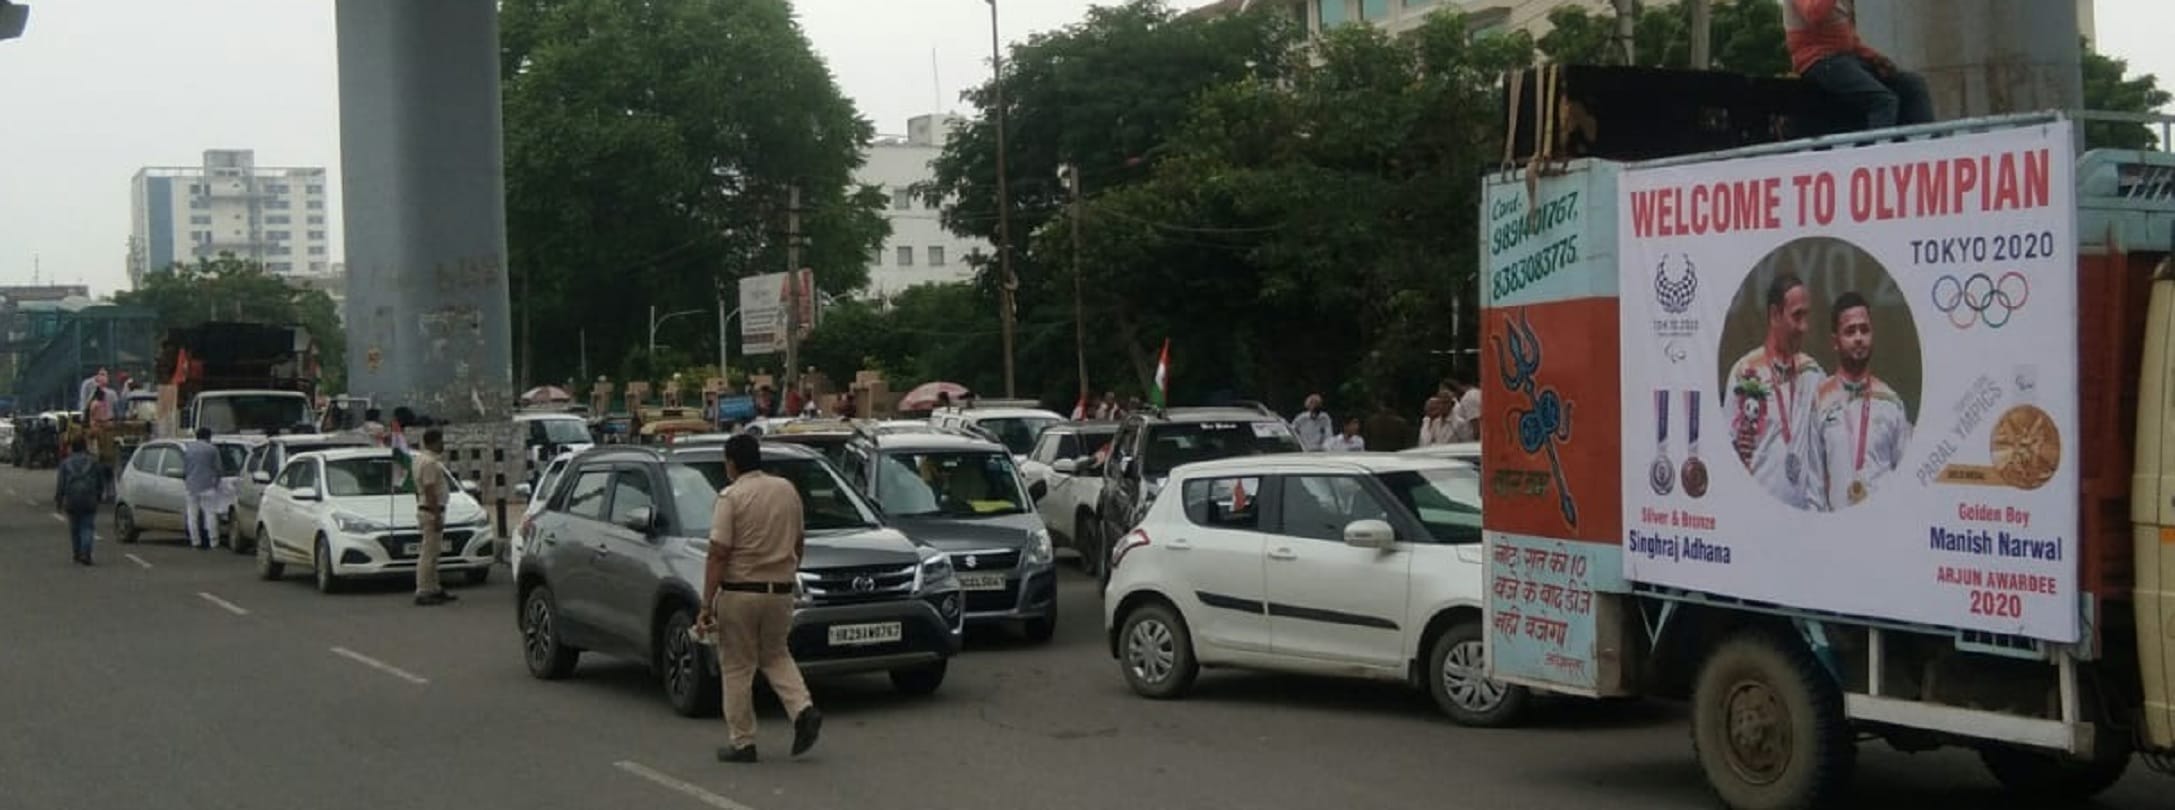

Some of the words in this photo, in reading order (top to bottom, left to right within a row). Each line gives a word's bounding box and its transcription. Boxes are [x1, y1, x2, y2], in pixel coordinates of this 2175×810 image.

[1630, 178, 1780, 238] WELCOME
[1793, 171, 1836, 227] TO
[1850, 148, 2050, 223] OLYMPIAN
[1911, 237, 1986, 264] TOKYO
[1993, 231, 2054, 261] 2020
[1959, 503, 2002, 522] Golden
[2006, 506, 2030, 527] Boy
[1630, 529, 1679, 563] Singhraj
[1682, 536, 1731, 564] Adhana
[1930, 527, 1992, 555] Manish
[1998, 531, 2062, 561] Narwal
[1937, 567, 1982, 586] ARJUN
[1987, 572, 2057, 594] AWARDEE
[1970, 590, 2021, 619] 2020
